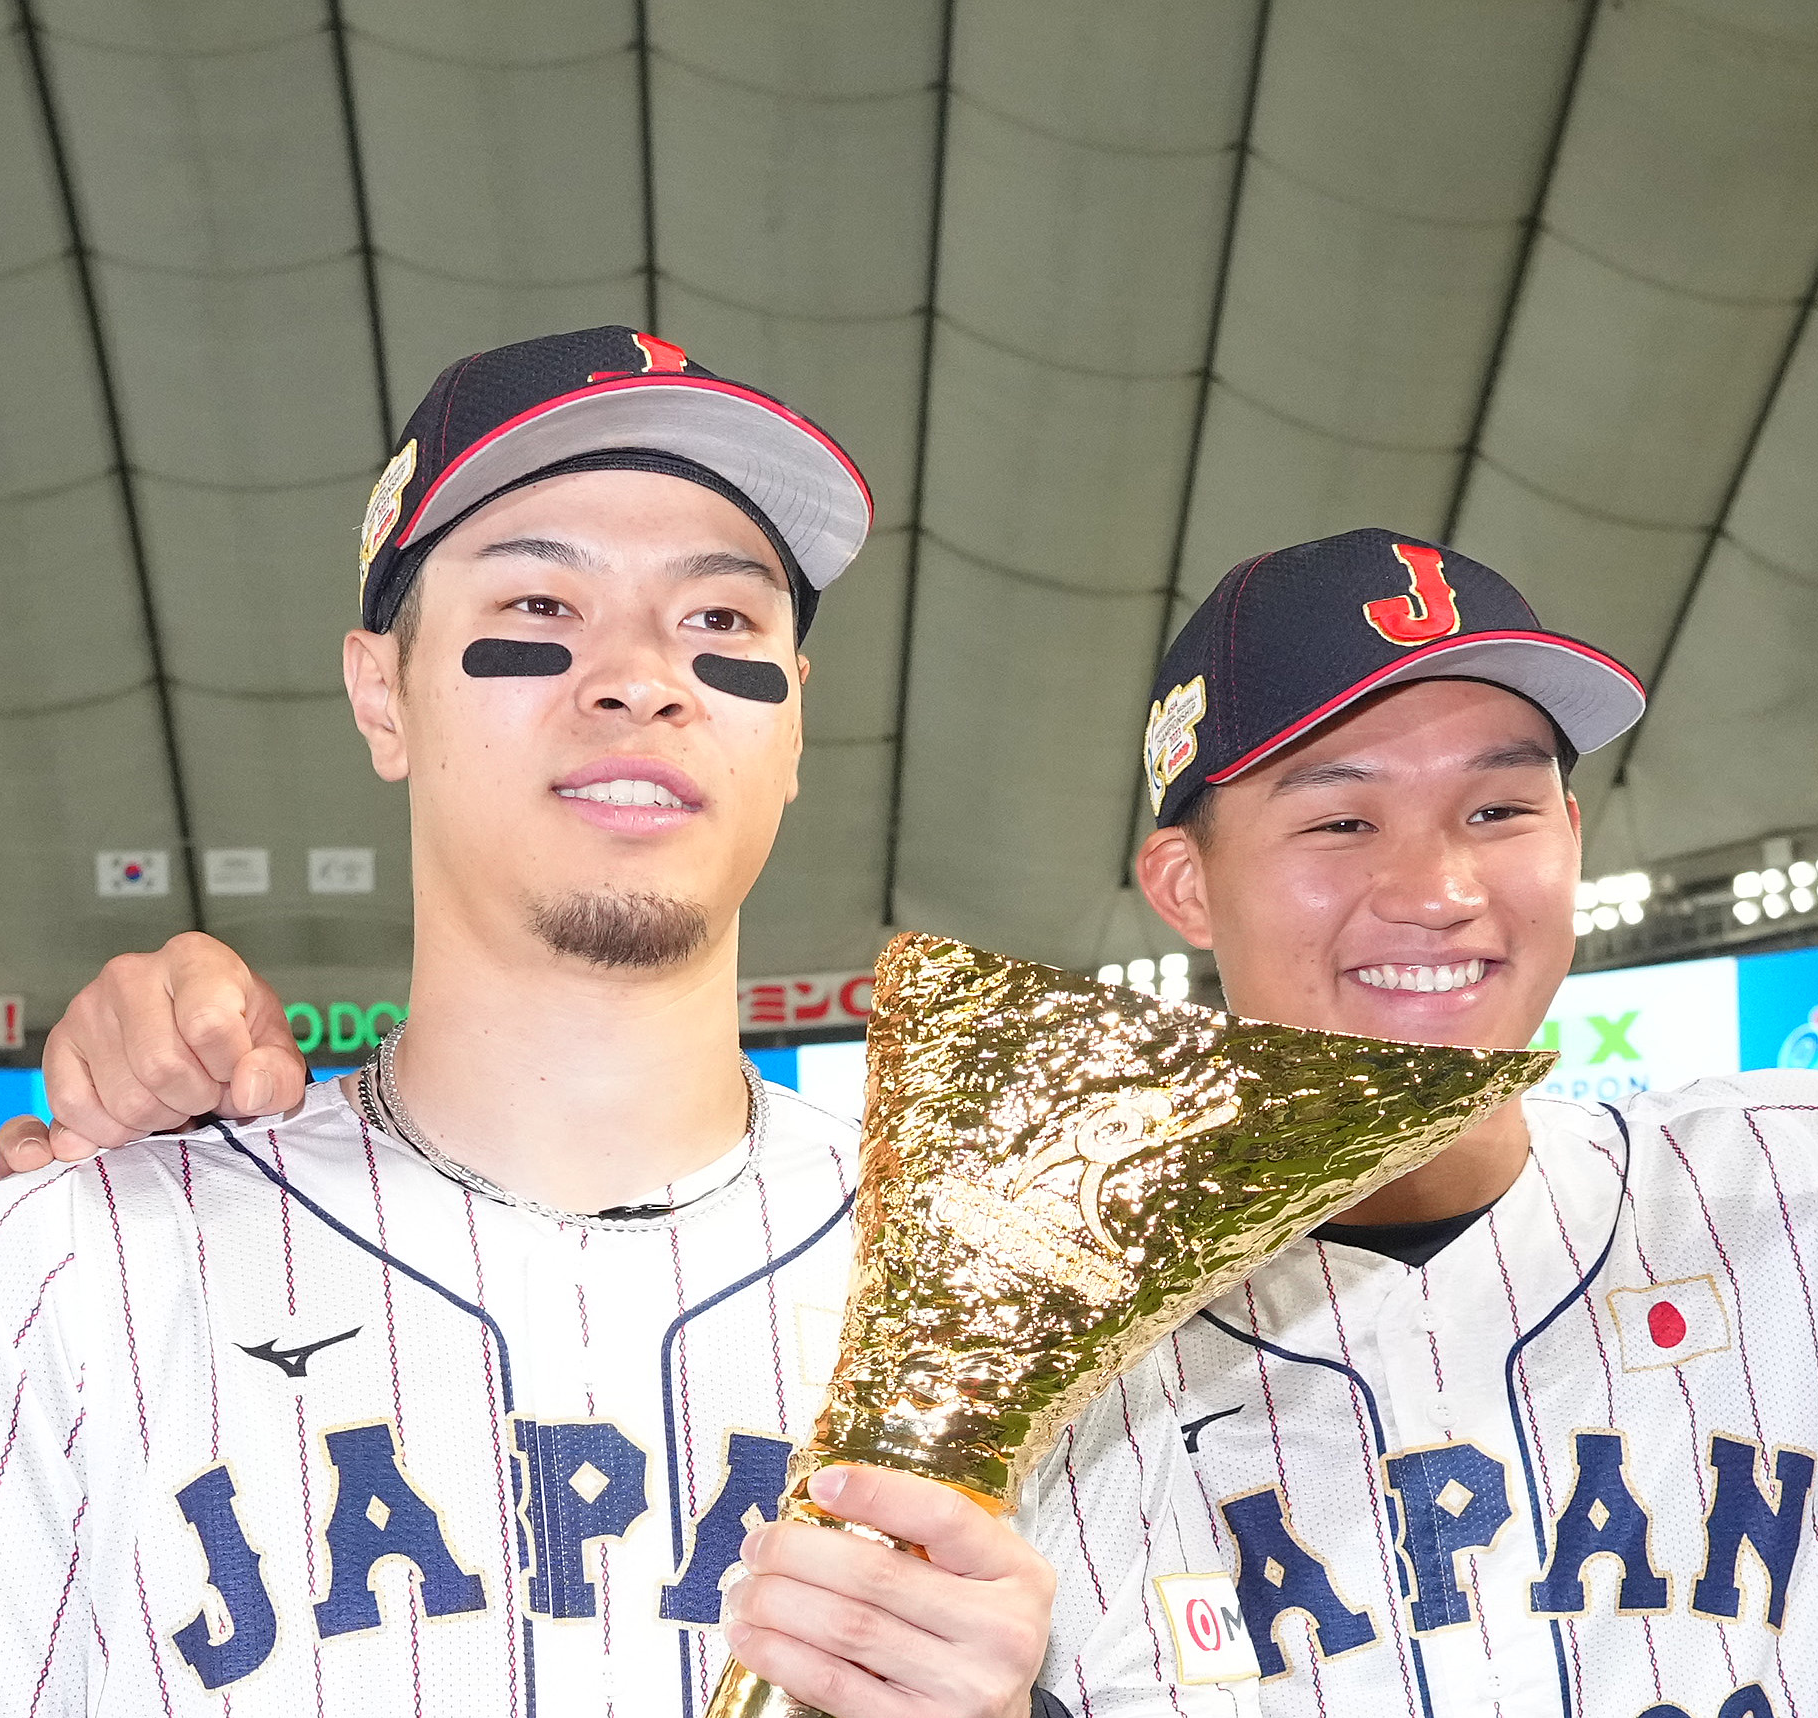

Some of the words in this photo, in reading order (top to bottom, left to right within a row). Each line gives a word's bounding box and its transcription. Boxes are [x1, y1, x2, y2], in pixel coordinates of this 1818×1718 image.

[1362, 543, 1461, 648] J
[1156, 701, 1198, 751] CHAMPIONSHIP
[1219, 1428, 1818, 1682] APAN
